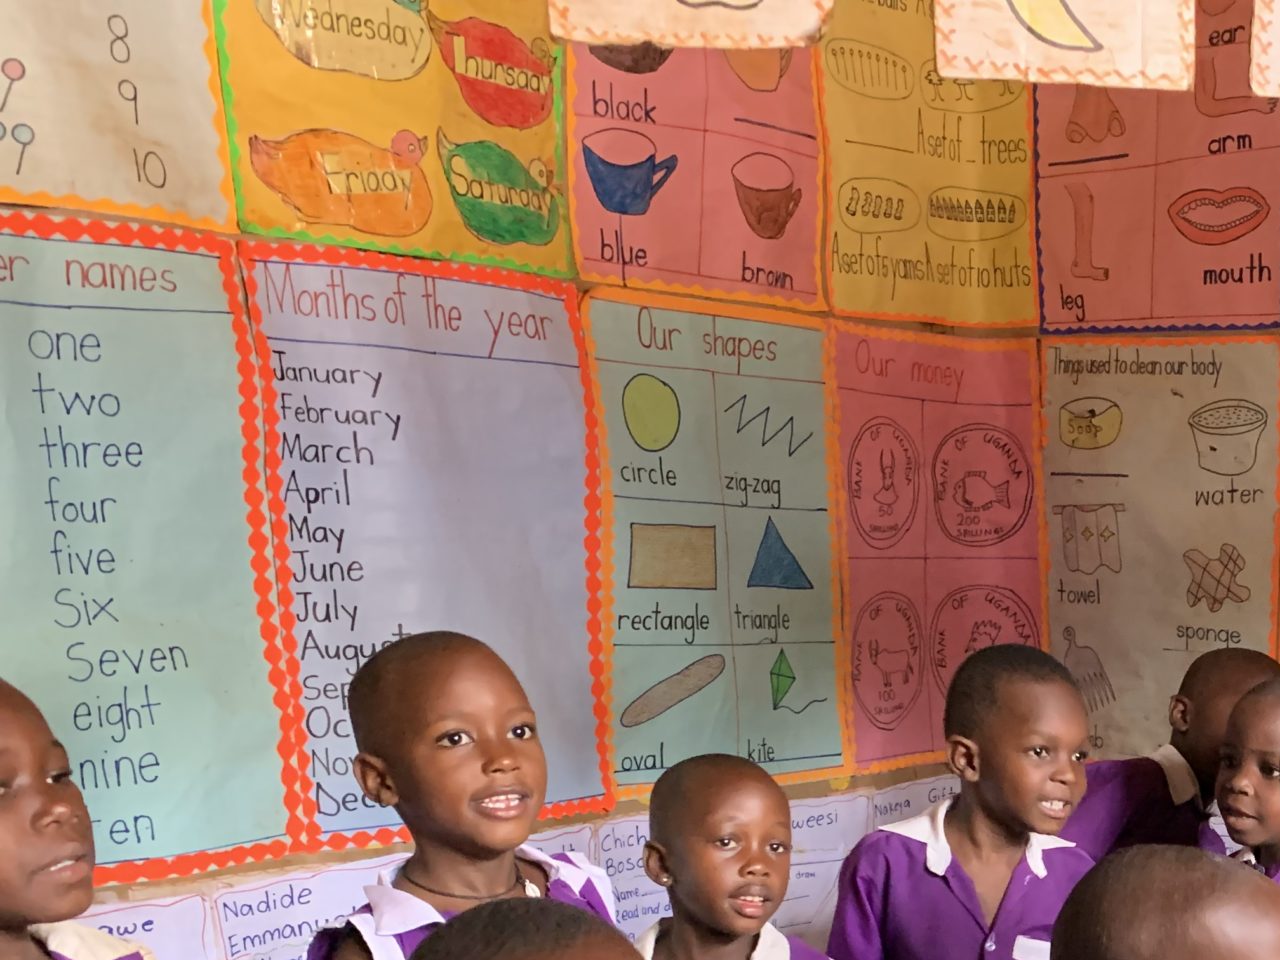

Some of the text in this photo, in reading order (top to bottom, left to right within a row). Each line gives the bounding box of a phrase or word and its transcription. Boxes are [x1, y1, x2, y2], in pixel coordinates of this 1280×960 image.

[108, 14, 130, 63] 8
[1208, 26, 1245, 46] ear
[117, 79, 139, 125] 9
[592, 80, 656, 124] black
[980, 115, 1027, 165] trees
[1208, 133, 1252, 155] arm
[132, 147, 167, 189] 10
[600, 226, 648, 269] blue
[992, 248, 1031, 288] huts
[65, 259, 177, 292] names
[1203, 253, 1272, 285] mouth
[264, 262, 553, 359] Months of the year
[1059, 284, 1085, 322] leg
[28, 329, 101, 362] one
[637, 306, 778, 375] Our shapes
[272, 350, 382, 398] January
[855, 339, 964, 403] Our money
[1048, 346, 1223, 388] Things used to clean our body
[32, 372, 120, 416] two
[281, 393, 401, 441] February
[39, 425, 143, 468] three
[281, 431, 374, 465] March
[284, 468, 350, 513] April
[620, 456, 676, 486] circle
[724, 472, 781, 509] zig-zag
[45, 476, 117, 523] four
[1195, 478, 1264, 506] water
[50, 530, 116, 575] five
[288, 512, 345, 553] May
[292, 550, 364, 583] June
[54, 588, 119, 629] Six
[296, 589, 357, 631] July
[1057, 579, 1101, 604] towel
[618, 602, 710, 645] rectangle
[734, 603, 790, 644] triangle
[66, 642, 188, 682] Seven
[73, 684, 162, 743] eight
[79, 750, 160, 789] nine
[621, 742, 664, 770] oval
[747, 737, 775, 763] kite
[91, 814, 156, 844] en
[792, 809, 838, 829] weesi
[222, 884, 312, 922] Nadide
[641, 903, 660, 915] and
